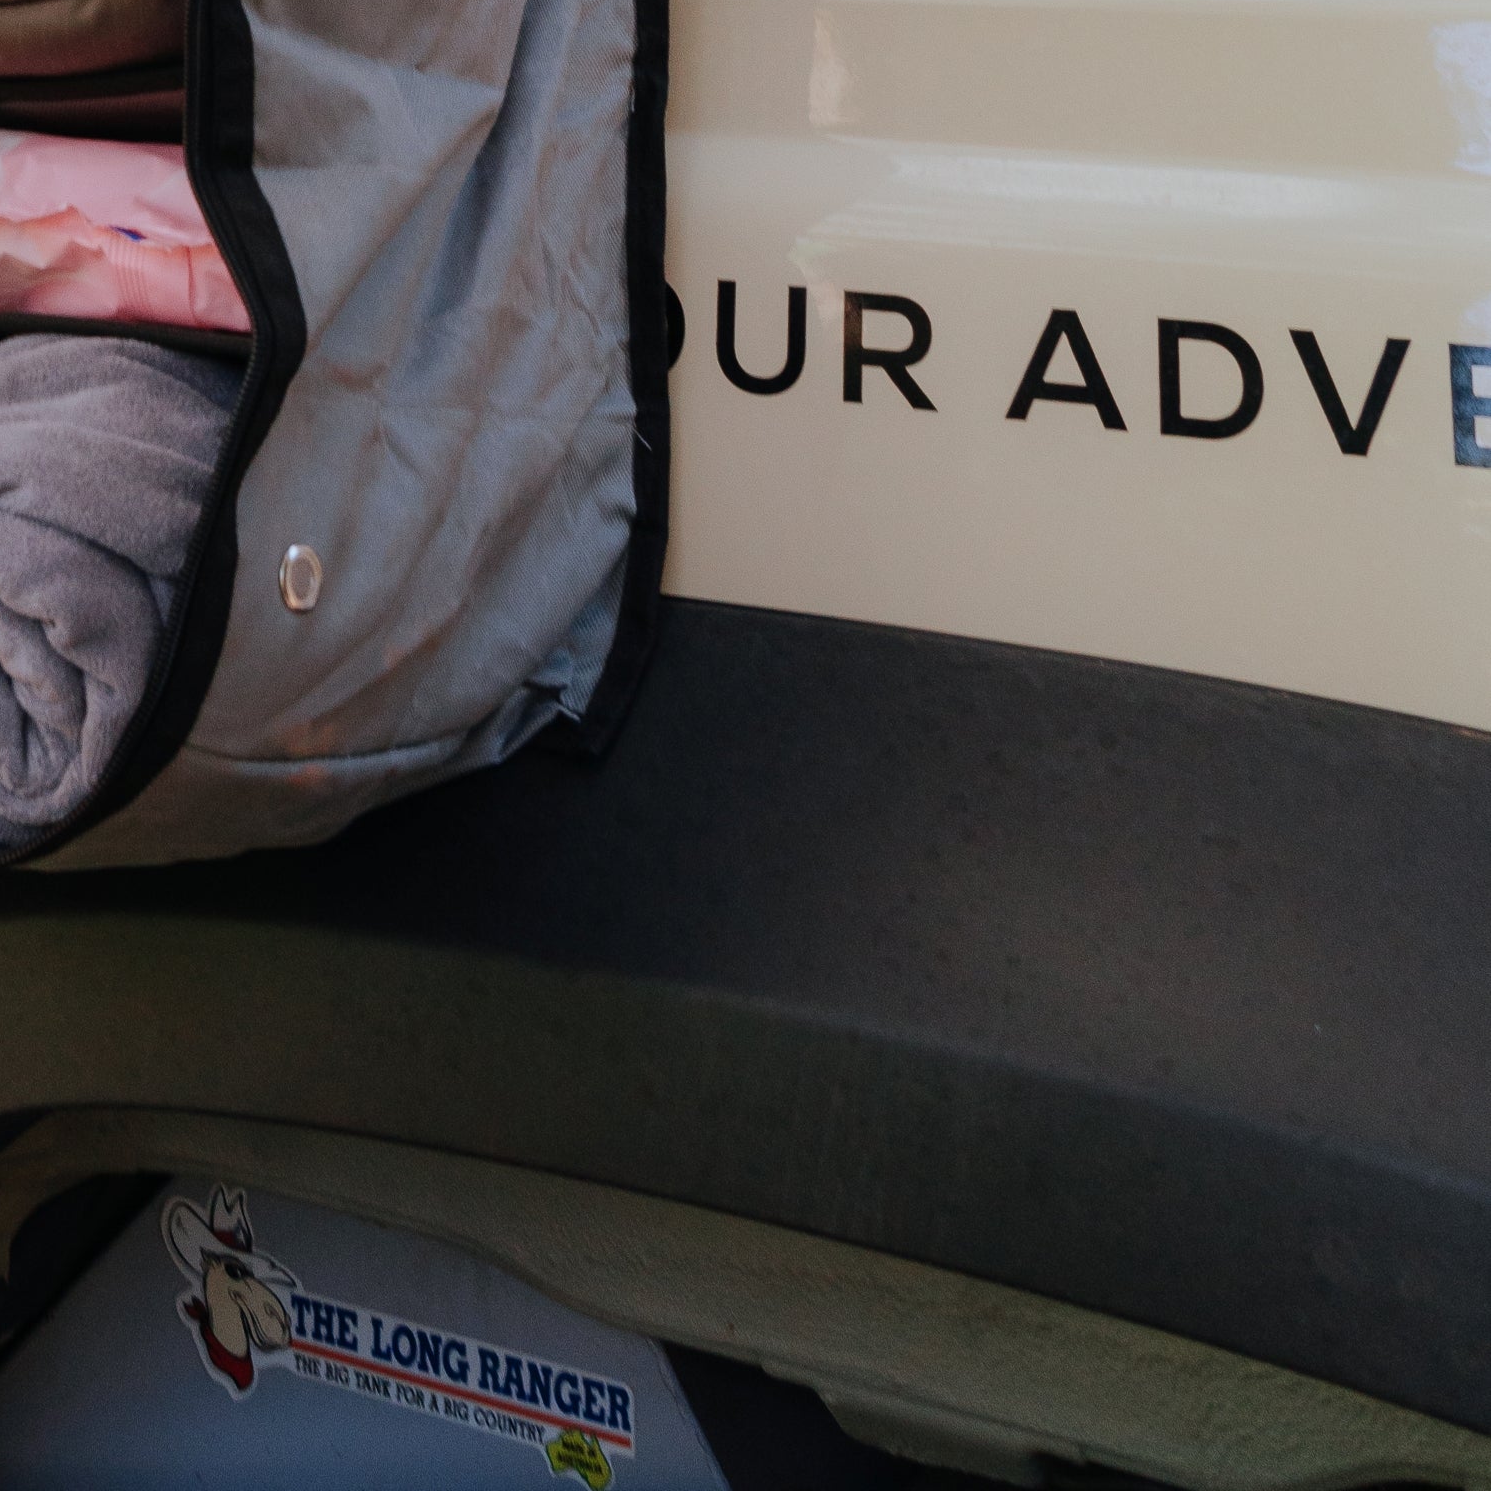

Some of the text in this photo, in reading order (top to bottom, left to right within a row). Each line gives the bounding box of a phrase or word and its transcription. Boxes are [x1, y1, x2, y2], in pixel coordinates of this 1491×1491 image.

[666, 278, 939, 414] UR
[291, 1294, 632, 1433] THE LONG RANGER
[294, 1353, 320, 1377] THE
[325, 1360, 349, 1386] BIG
[396, 1382, 425, 1411] FOR
[428, 1392, 440, 1412] A
[442, 1395, 469, 1421] BIG
[473, 1409, 546, 1446] COUNTRY
